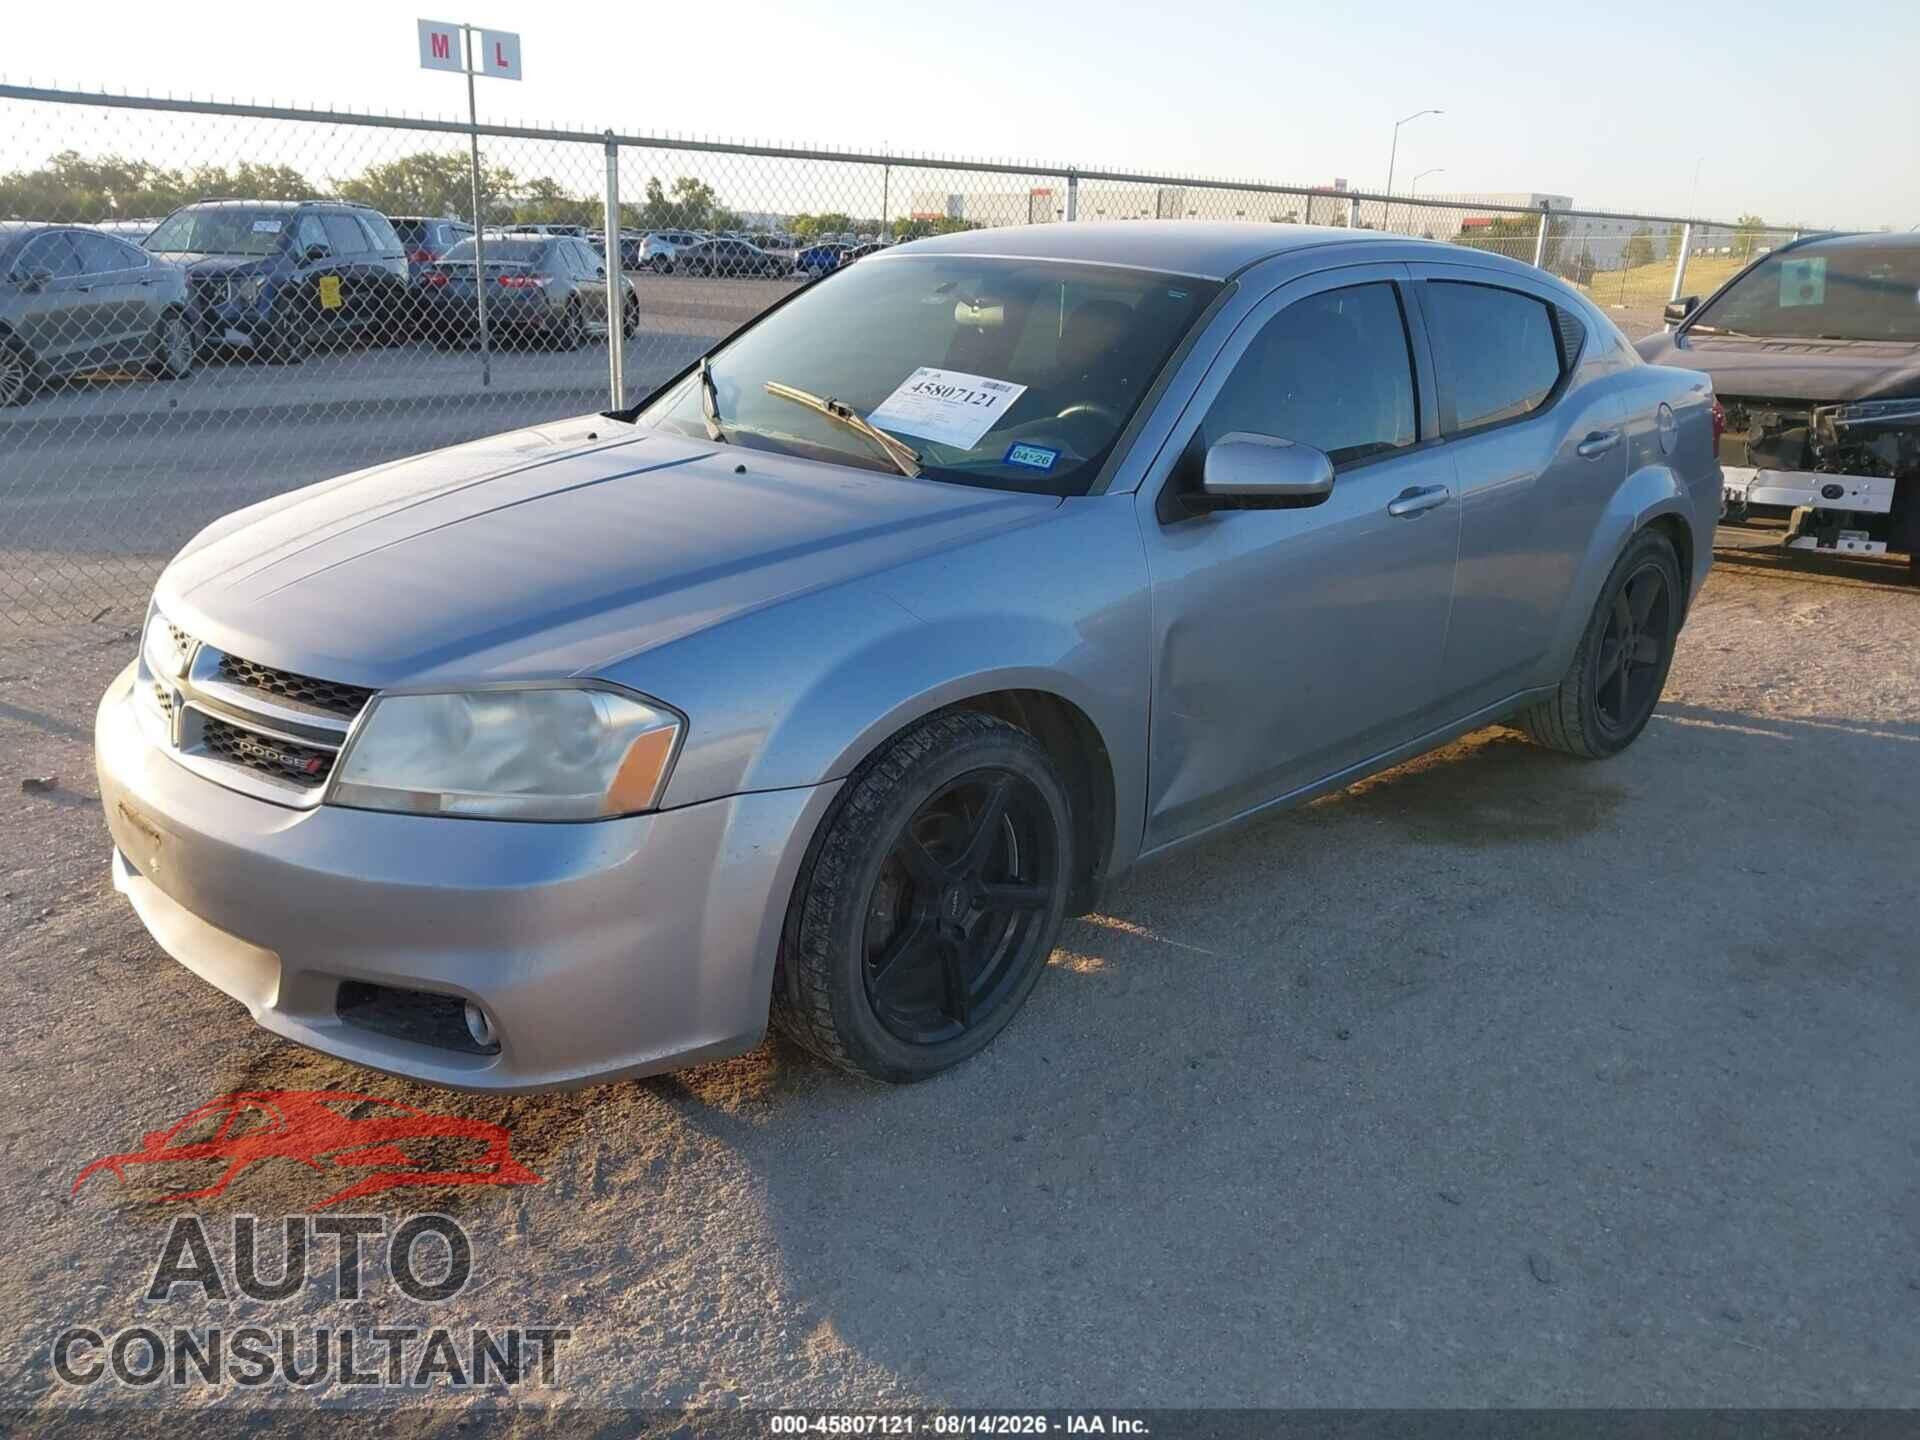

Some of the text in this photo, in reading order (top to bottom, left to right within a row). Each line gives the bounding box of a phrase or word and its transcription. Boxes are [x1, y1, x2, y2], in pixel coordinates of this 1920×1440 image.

[431, 32, 449, 59] M
[496, 42, 508, 67] L
[911, 382, 997, 407] 45807121
[240, 741, 305, 768] DODGE
